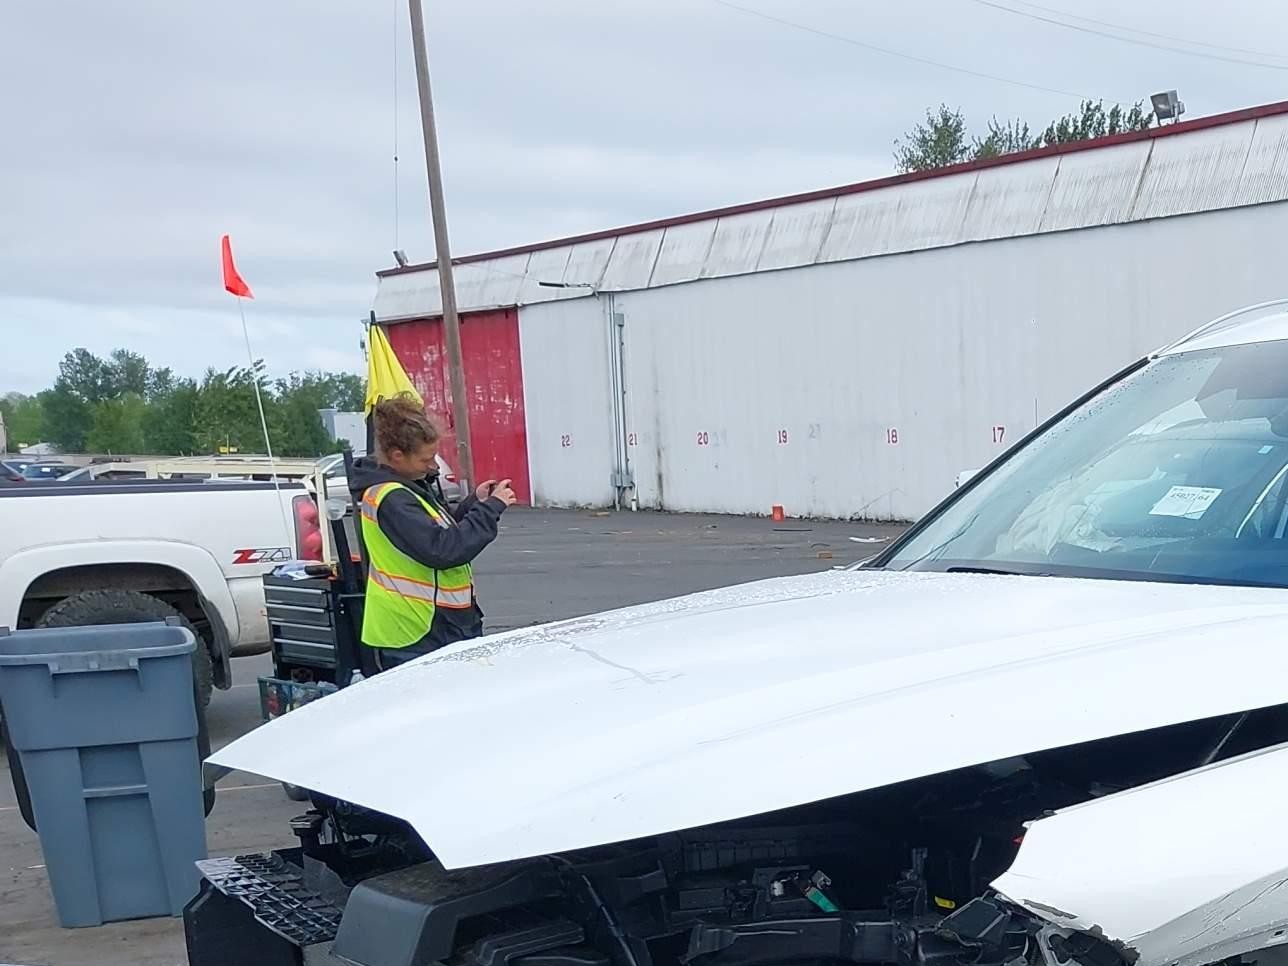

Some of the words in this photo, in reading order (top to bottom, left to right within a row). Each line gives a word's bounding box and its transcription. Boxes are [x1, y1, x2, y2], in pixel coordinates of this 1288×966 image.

[561, 434, 571, 447] 22
[629, 433, 638, 446] 21
[697, 431, 709, 445] 20
[777, 430, 788, 444] 19
[886, 428, 898, 443] 18
[992, 426, 1005, 443] 17
[232, 547, 292, 564] Z71
